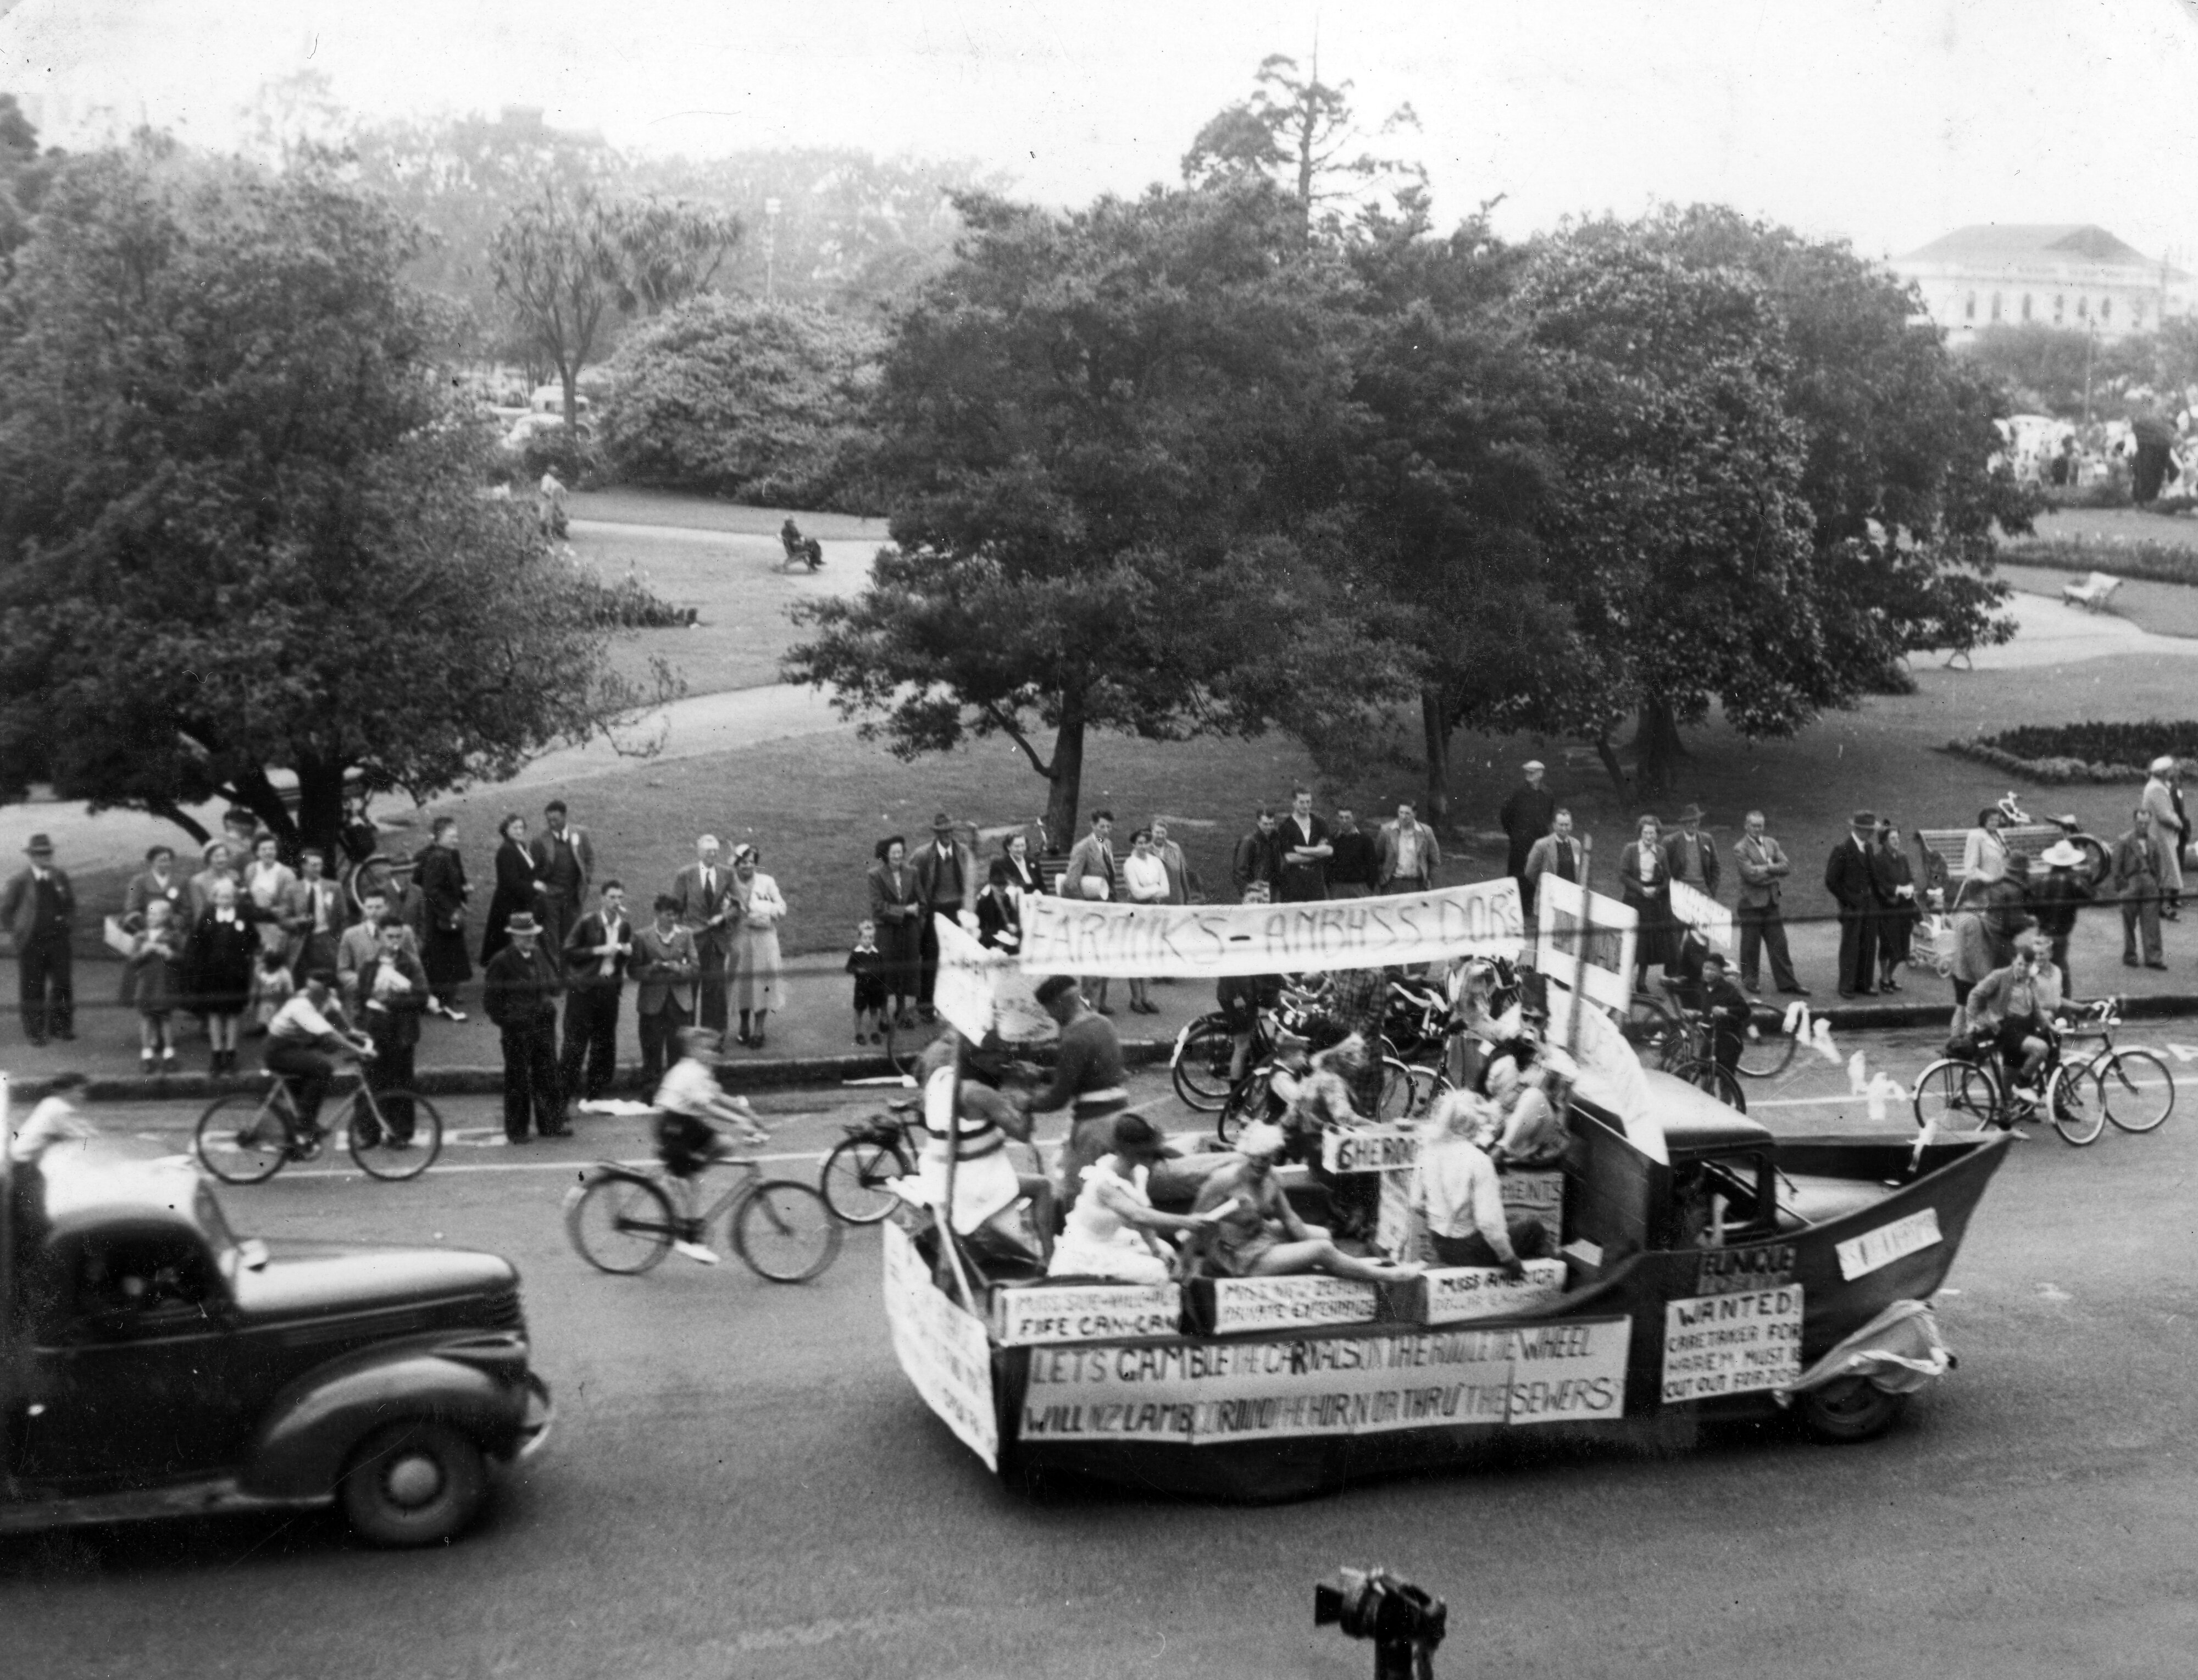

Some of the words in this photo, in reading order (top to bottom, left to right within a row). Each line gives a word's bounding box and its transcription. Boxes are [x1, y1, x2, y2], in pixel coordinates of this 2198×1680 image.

[1485, 1268, 1556, 1288] AMECA
[1517, 1326, 1594, 1360] WHEEL
[1511, 1376, 1614, 1415] SEWERS
